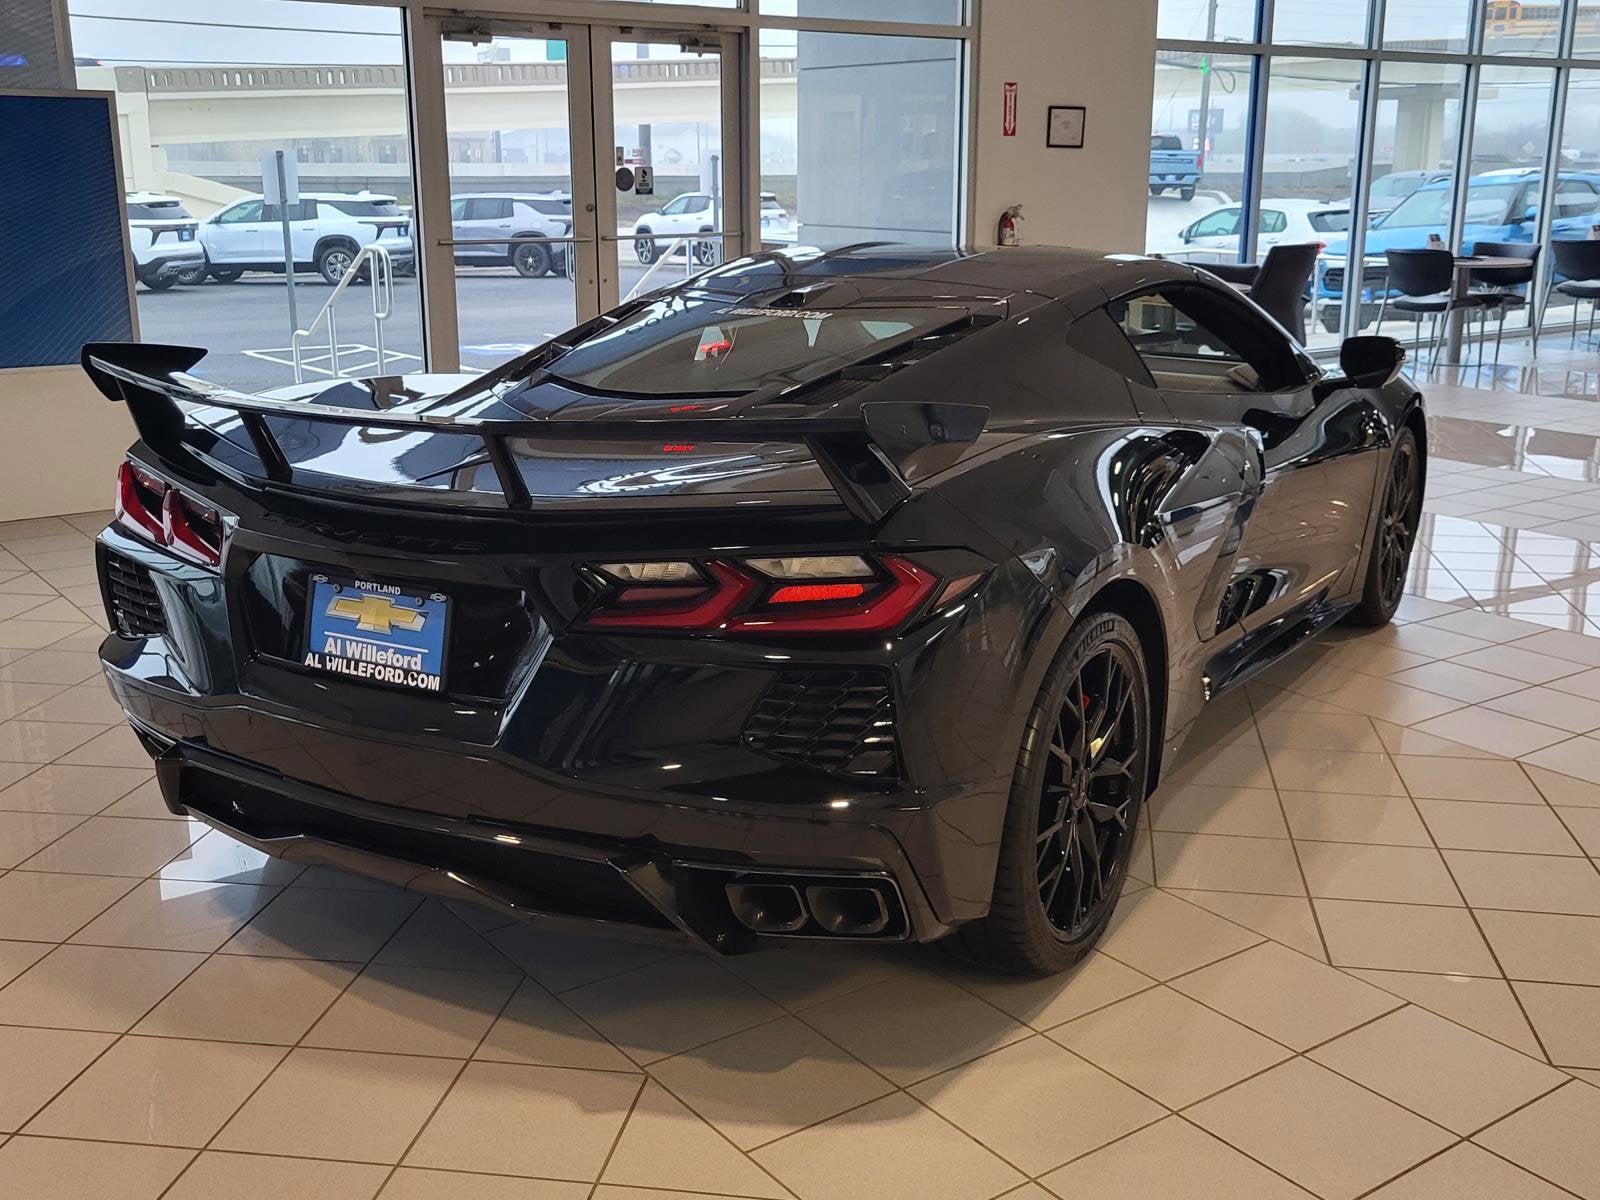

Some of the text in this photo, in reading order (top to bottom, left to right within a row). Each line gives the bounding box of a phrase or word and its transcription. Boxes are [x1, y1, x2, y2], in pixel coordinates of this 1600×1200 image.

[354, 580, 402, 595] PORTLAND
[324, 637, 422, 671] Al Willeford
[304, 652, 440, 691] AL WILLEFORD.COM
